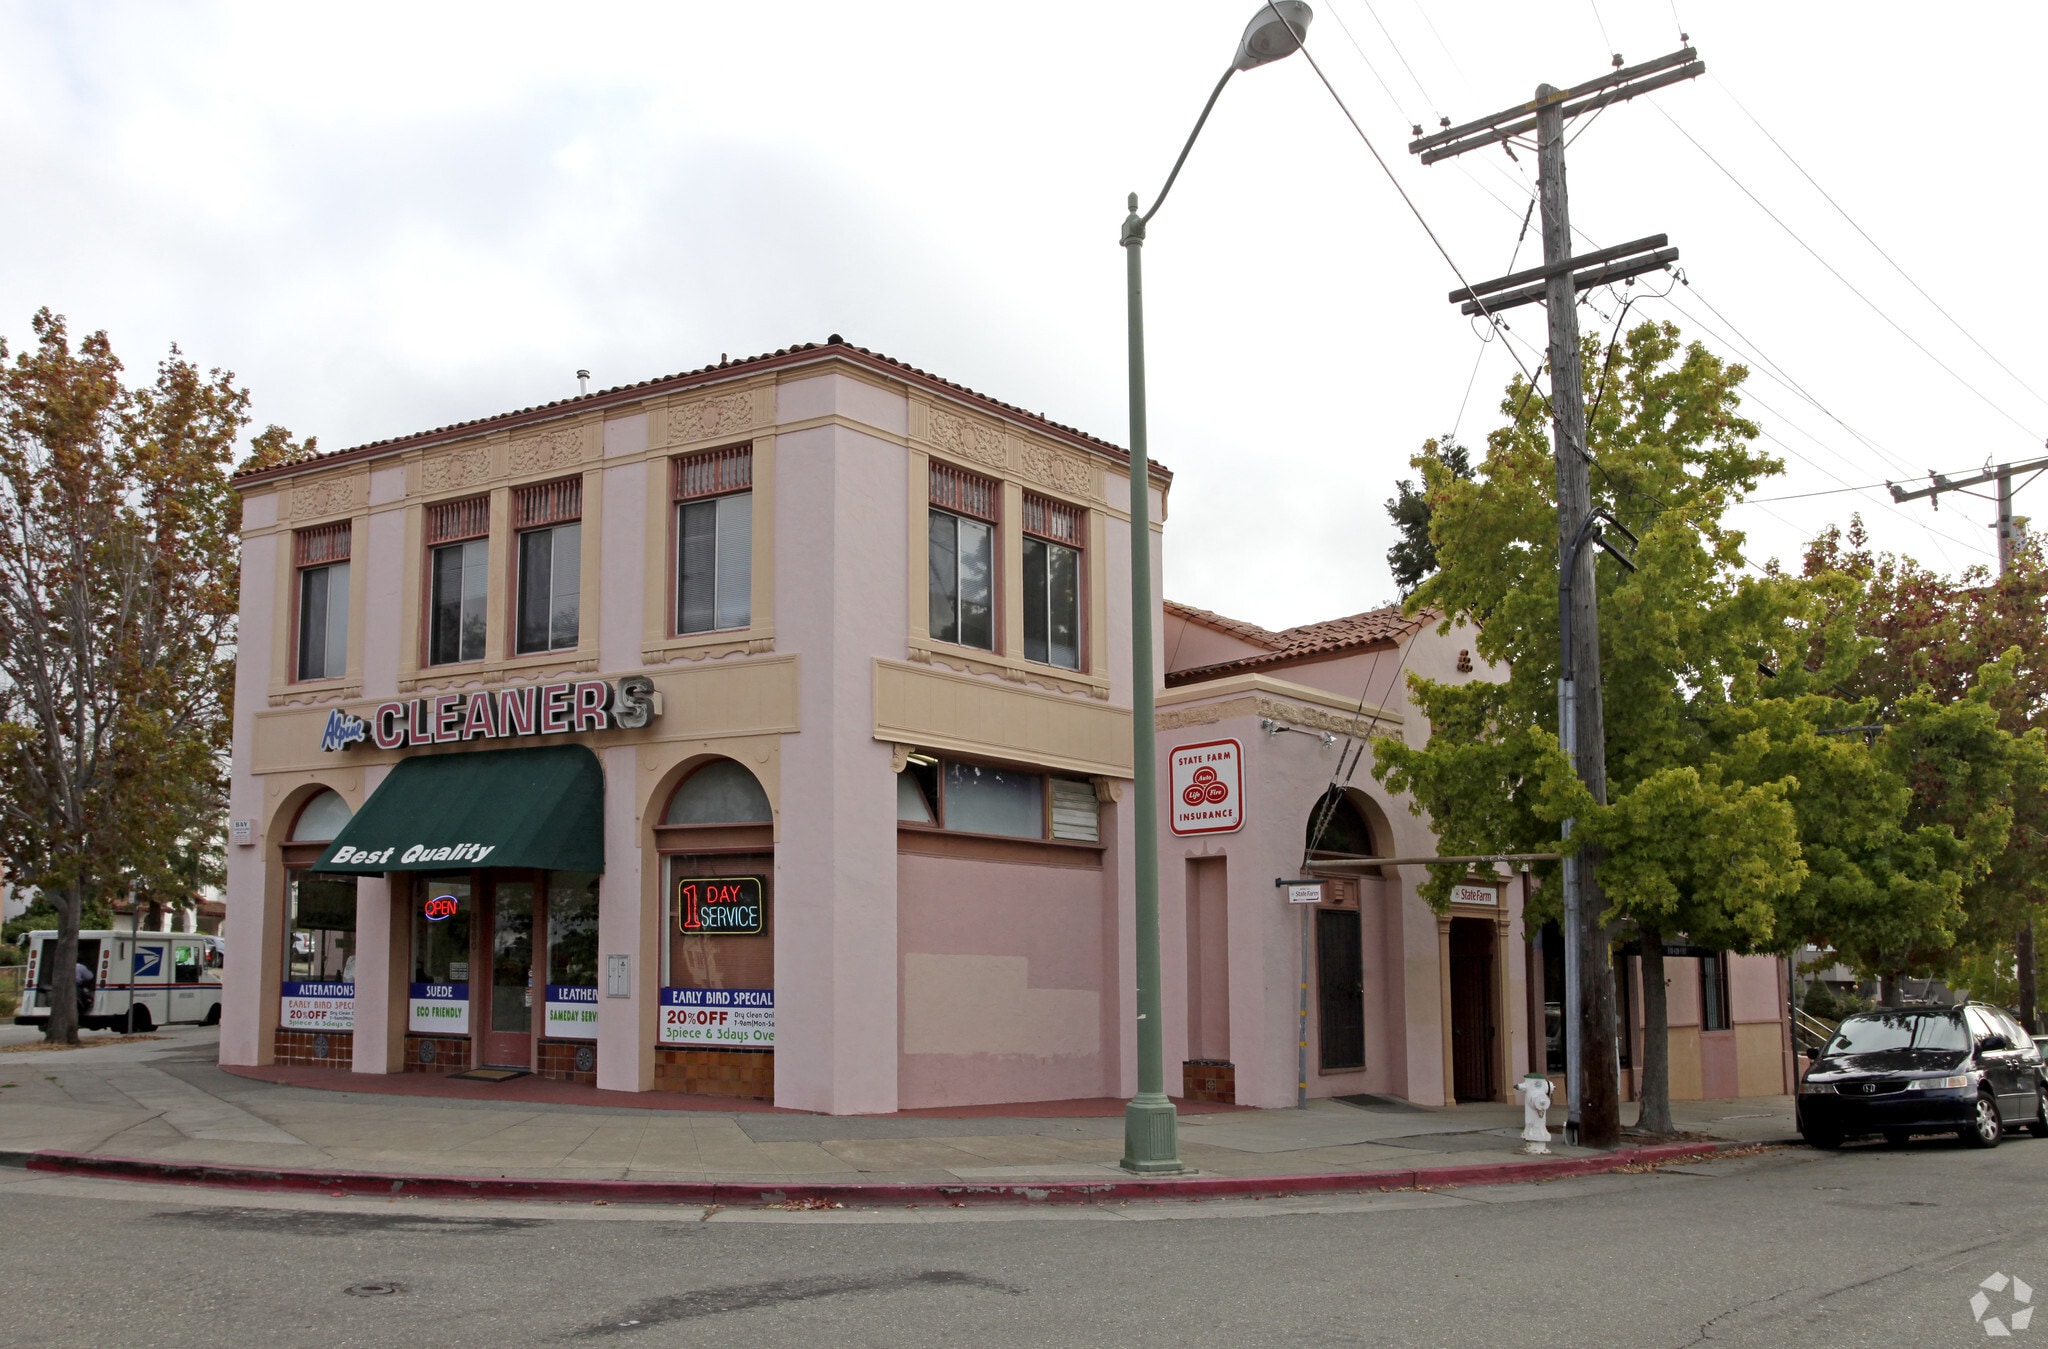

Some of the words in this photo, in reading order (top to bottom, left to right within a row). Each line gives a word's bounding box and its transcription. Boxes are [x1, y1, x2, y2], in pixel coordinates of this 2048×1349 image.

[320, 708, 365, 751] Alpine
[374, 675, 655, 750] CLEANERS
[1179, 755, 1202, 766] STATE
[1207, 751, 1231, 762] FARM
[1189, 791, 1200, 800] Life
[1179, 808, 1233, 822] INSURANCE
[330, 845, 395, 864] Best
[401, 843, 496, 864] Quality
[424, 900, 457, 916] OPEN
[683, 884, 701, 928] 1
[707, 885, 741, 903] DAY
[700, 905, 758, 927] SERVICE
[298, 984, 354, 996] ALTERATIONS
[426, 985, 453, 998] SUEDE
[558, 988, 598, 1001] LEATHER
[289, 1000, 311, 1009] EARLY
[314, 1001, 332, 1009] BIRD
[672, 990, 703, 1004] EARLY
[705, 991, 731, 1005] BIRD
[733, 992, 773, 1006] SPECIAL
[416, 1006, 430, 1017] ECO
[432, 1006, 463, 1018] FRIENDLY
[550, 1010, 579, 1021] SAMEDAY
[734, 1011, 745, 1019] Dry
[746, 1011, 763, 1019] Clean
[322, 1020, 343, 1028] 3days
[666, 1027, 701, 1040] 3piece
[705, 1028, 713, 1039] &
[717, 1027, 749, 1043] 3days
